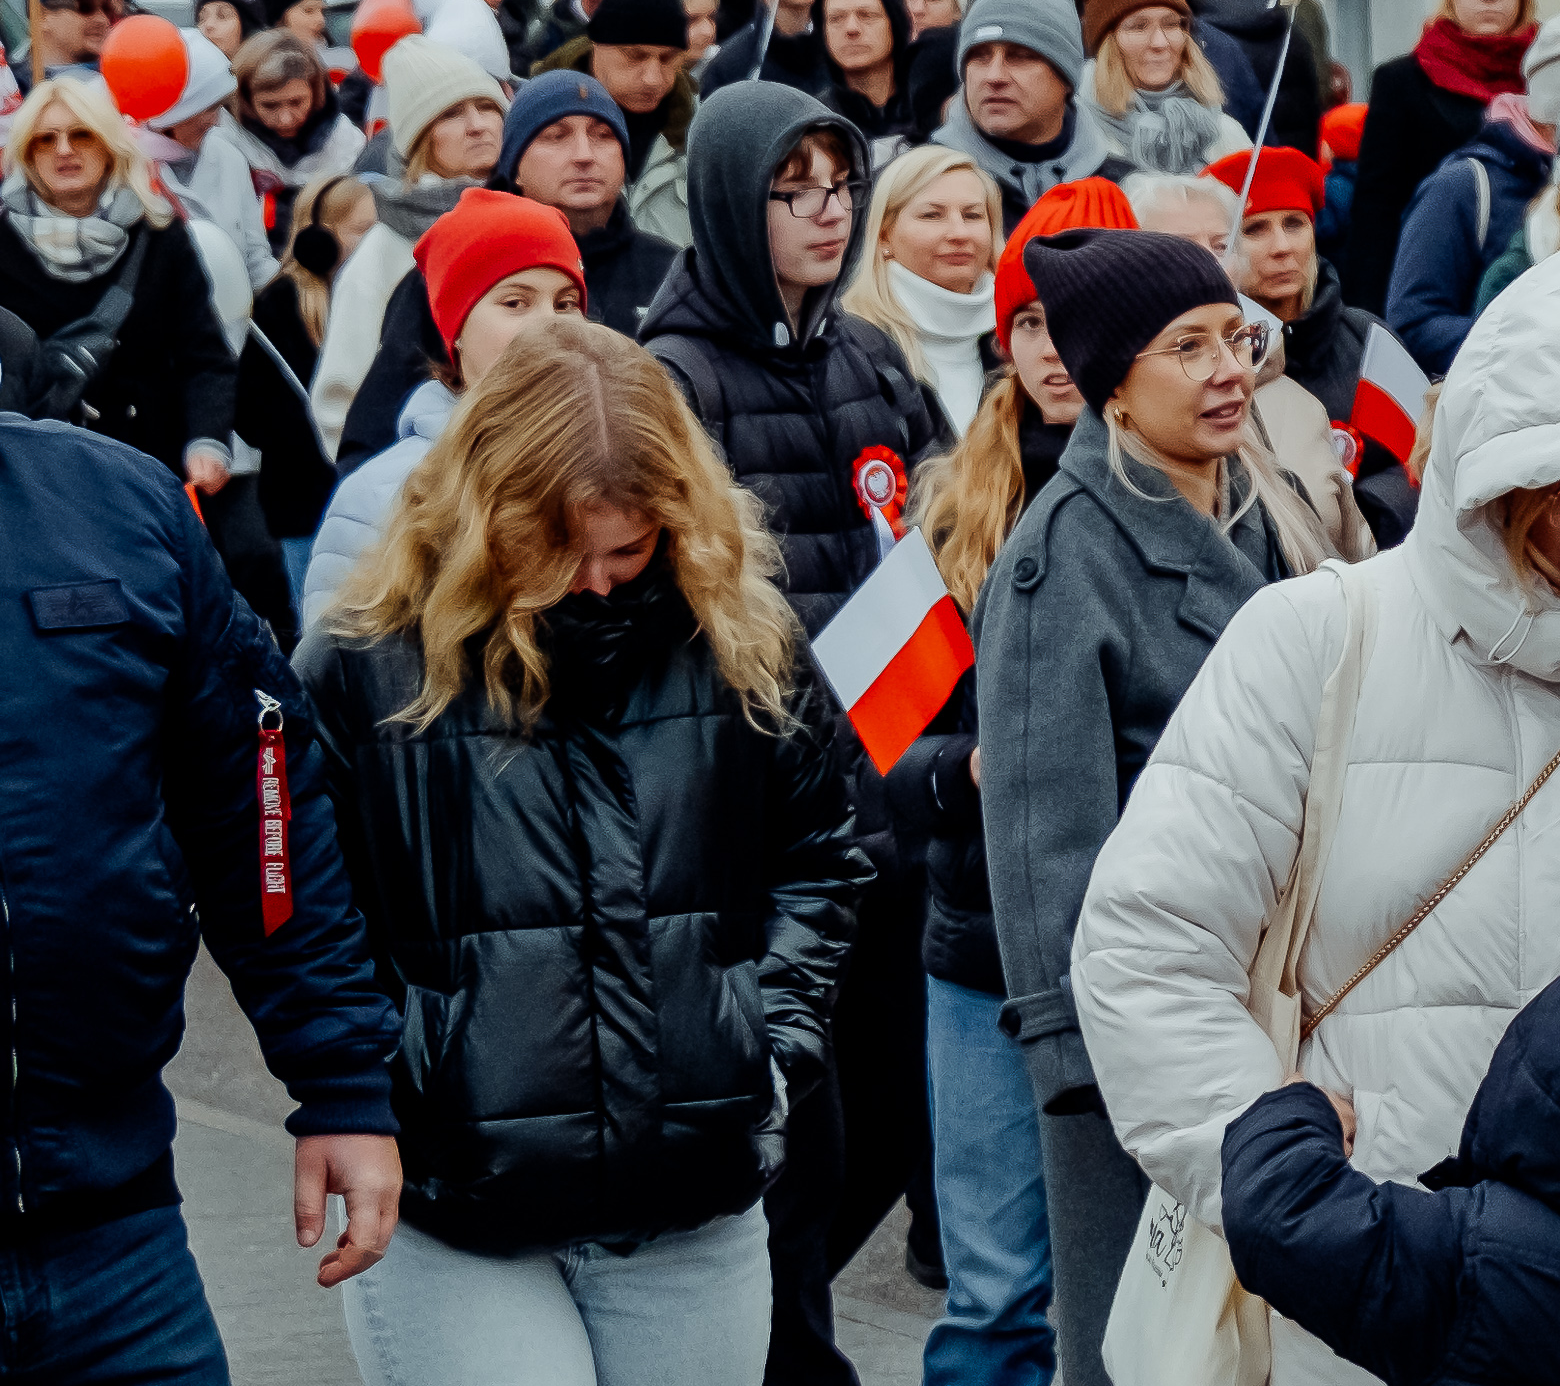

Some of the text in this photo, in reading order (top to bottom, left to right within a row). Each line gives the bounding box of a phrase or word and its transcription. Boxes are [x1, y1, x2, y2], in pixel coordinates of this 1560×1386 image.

[262, 777, 286, 894] REMOVE BEFORE FLIGHT
